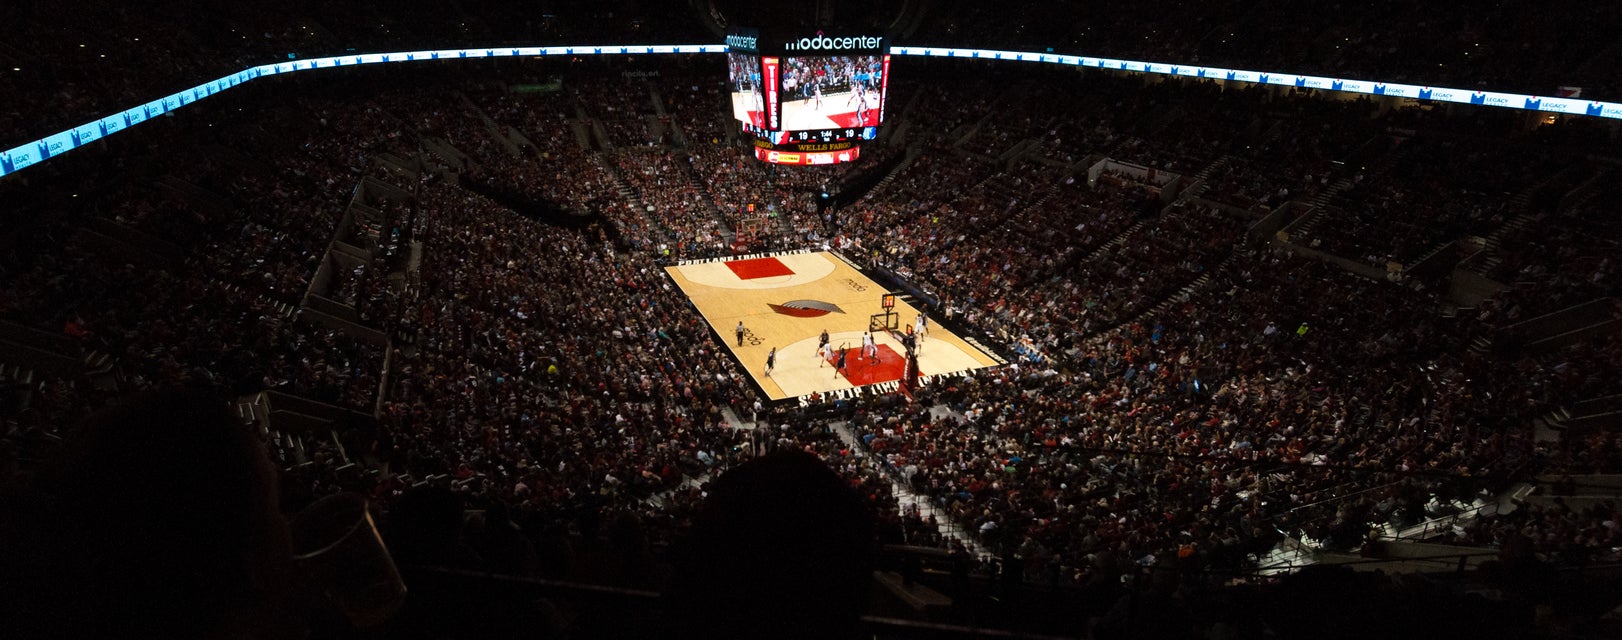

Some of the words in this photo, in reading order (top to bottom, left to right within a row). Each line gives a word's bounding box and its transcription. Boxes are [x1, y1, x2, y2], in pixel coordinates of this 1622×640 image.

[768, 65, 778, 128] TIRES
[81, 130, 92, 140] LEGACY
[798, 131, 808, 140] 19
[820, 130, 832, 138] 1:44
[845, 129, 855, 138] 19
[50, 141, 63, 151] LEGACY
[798, 143, 828, 151] WELLS
[829, 142, 851, 150] FARGO
[13, 153, 30, 165] LEGACY
[678, 256, 734, 266] PORTLAND
[737, 252, 766, 261] TRAIL
